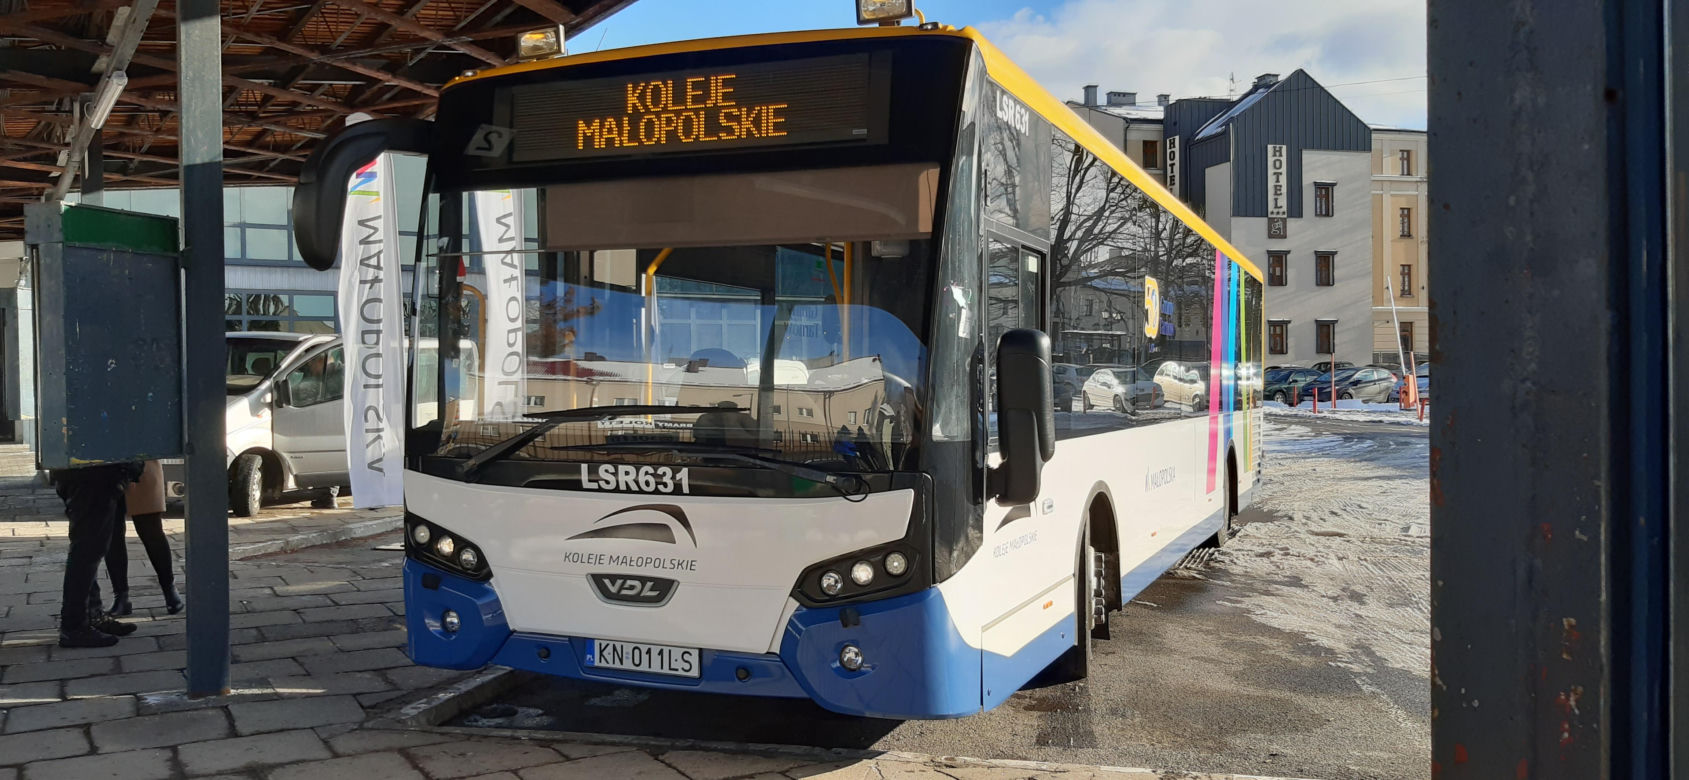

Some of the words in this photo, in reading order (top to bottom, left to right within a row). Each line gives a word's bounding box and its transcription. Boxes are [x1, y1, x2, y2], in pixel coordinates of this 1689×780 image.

[626, 74, 736, 114] KOLEJE
[577, 103, 788, 150] MAŁOPOLSKIE
[996, 90, 1029, 137] LSR631
[1272, 145, 1284, 210] HOTEL
[580, 463, 690, 495] LSR631
[563, 551, 606, 566] KOLEJE
[608, 554, 698, 572] MAŁOPOLSKIE
[602, 578, 661, 597] VDL
[599, 643, 624, 666] KN
